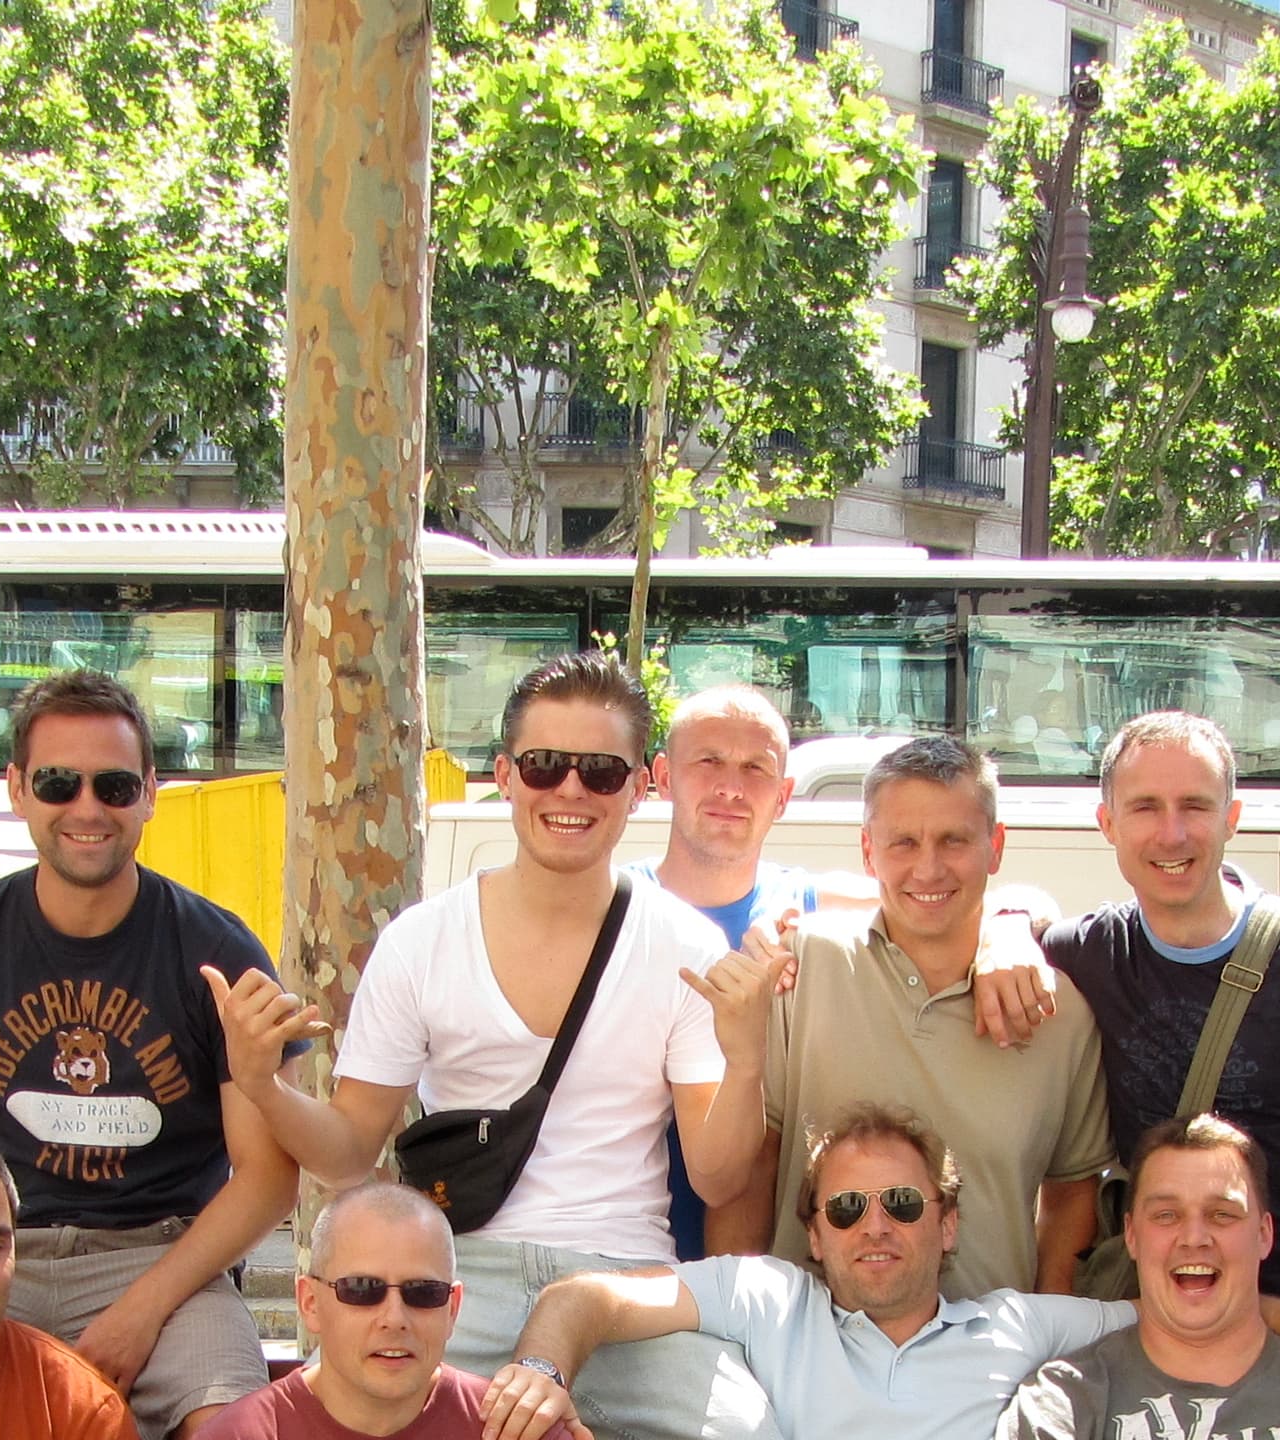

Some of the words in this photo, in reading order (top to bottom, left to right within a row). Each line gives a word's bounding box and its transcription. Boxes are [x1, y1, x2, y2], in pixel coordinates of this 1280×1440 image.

[134, 1033, 191, 1105] AND
[41, 1100, 63, 1113] NY
[77, 1103, 129, 1117] TRACK
[52, 1119, 87, 1133] AND
[98, 1121, 149, 1135] FIELD
[35, 1144, 127, 1183] FITCH
